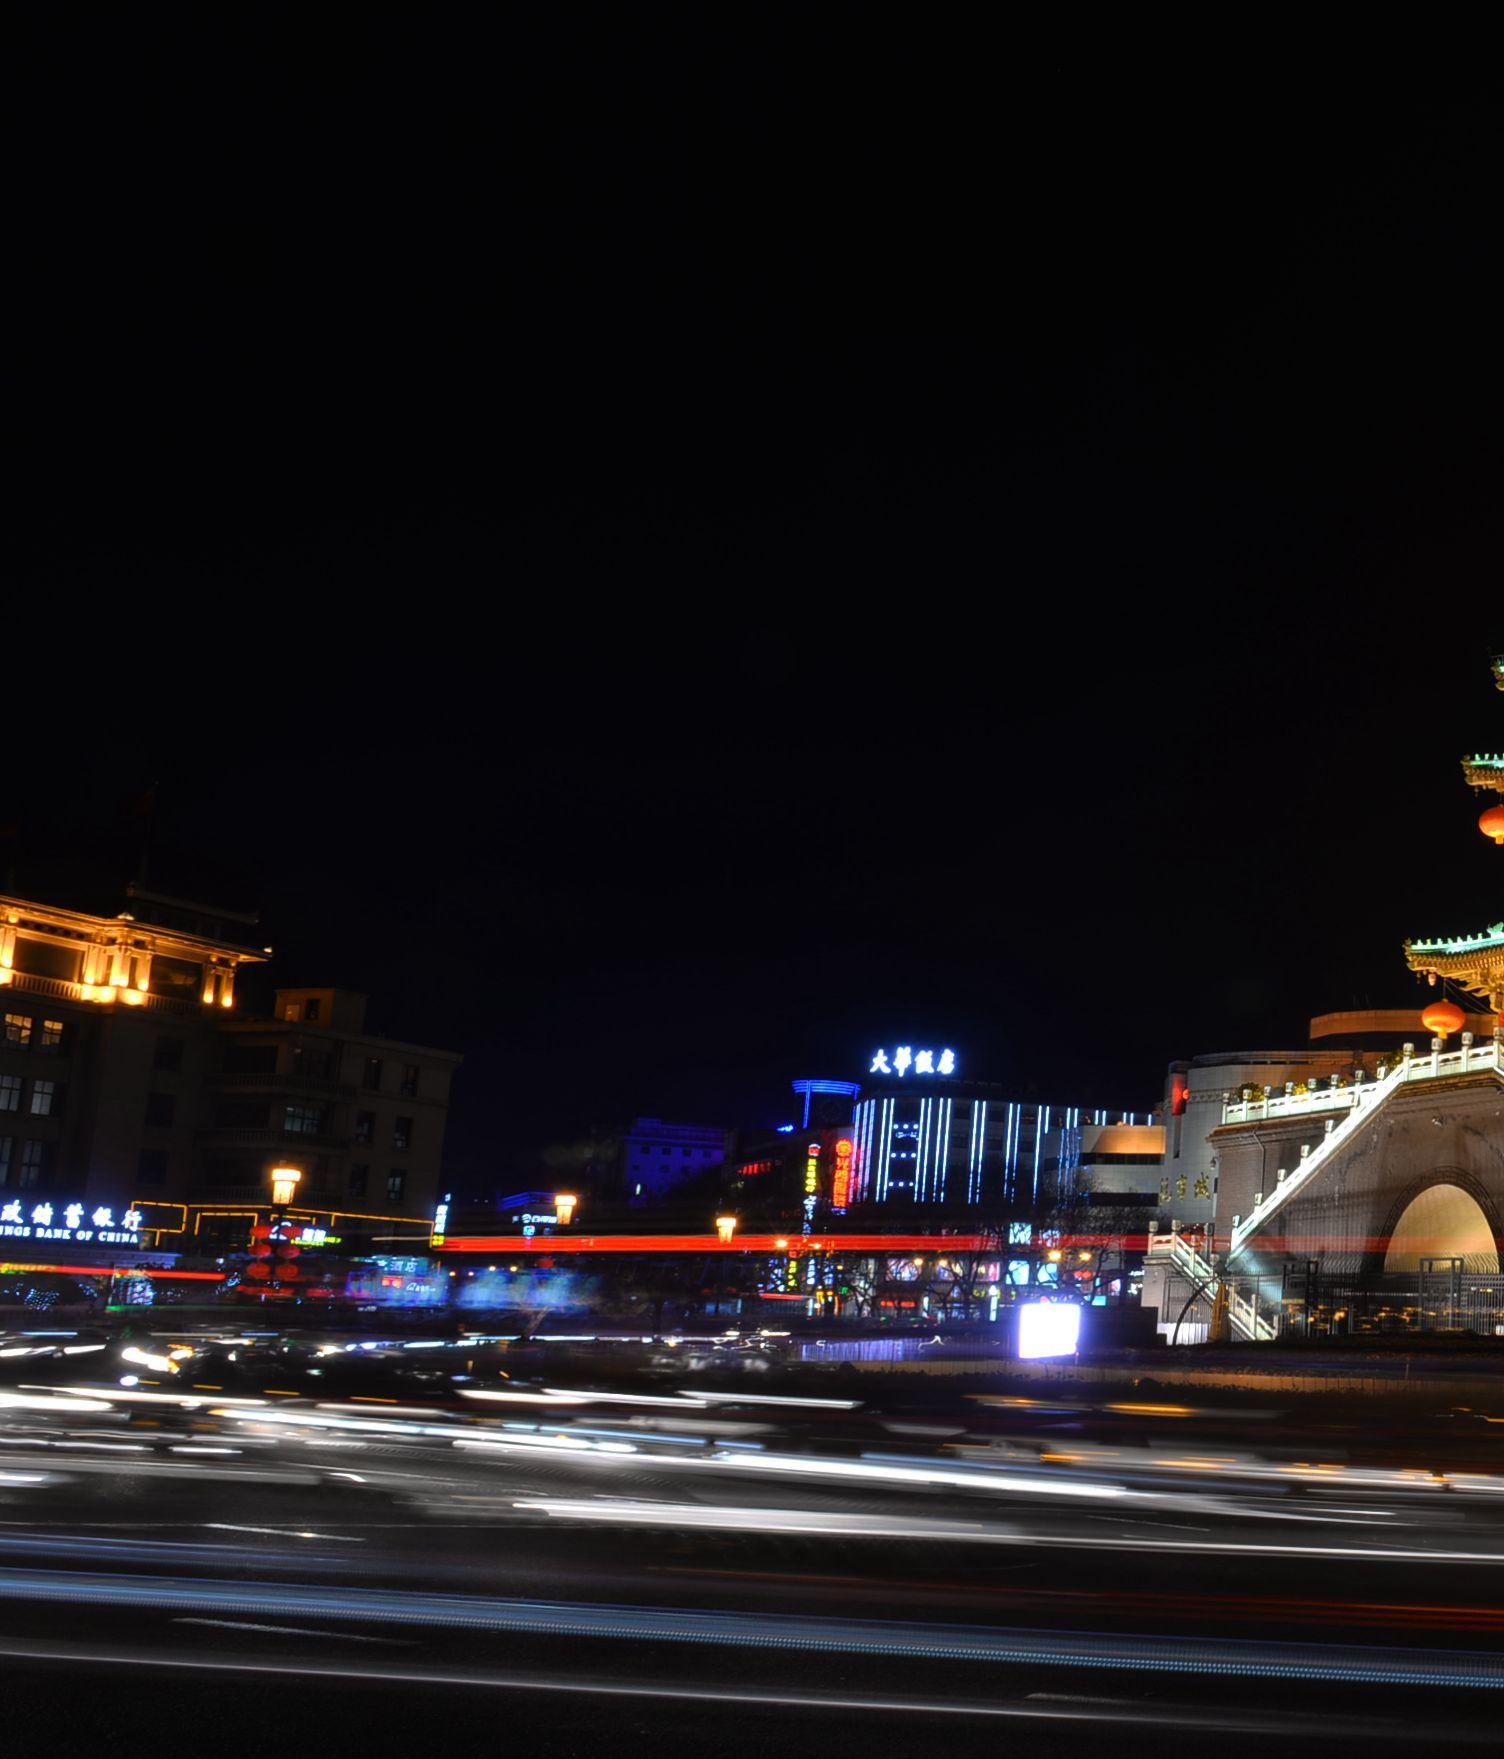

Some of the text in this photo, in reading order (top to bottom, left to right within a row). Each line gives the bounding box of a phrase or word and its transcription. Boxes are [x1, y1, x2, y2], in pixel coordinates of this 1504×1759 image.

[35, 1218, 72, 1240] BANK
[76, 1229, 94, 1241] OF
[98, 1231, 138, 1243] CHINA
